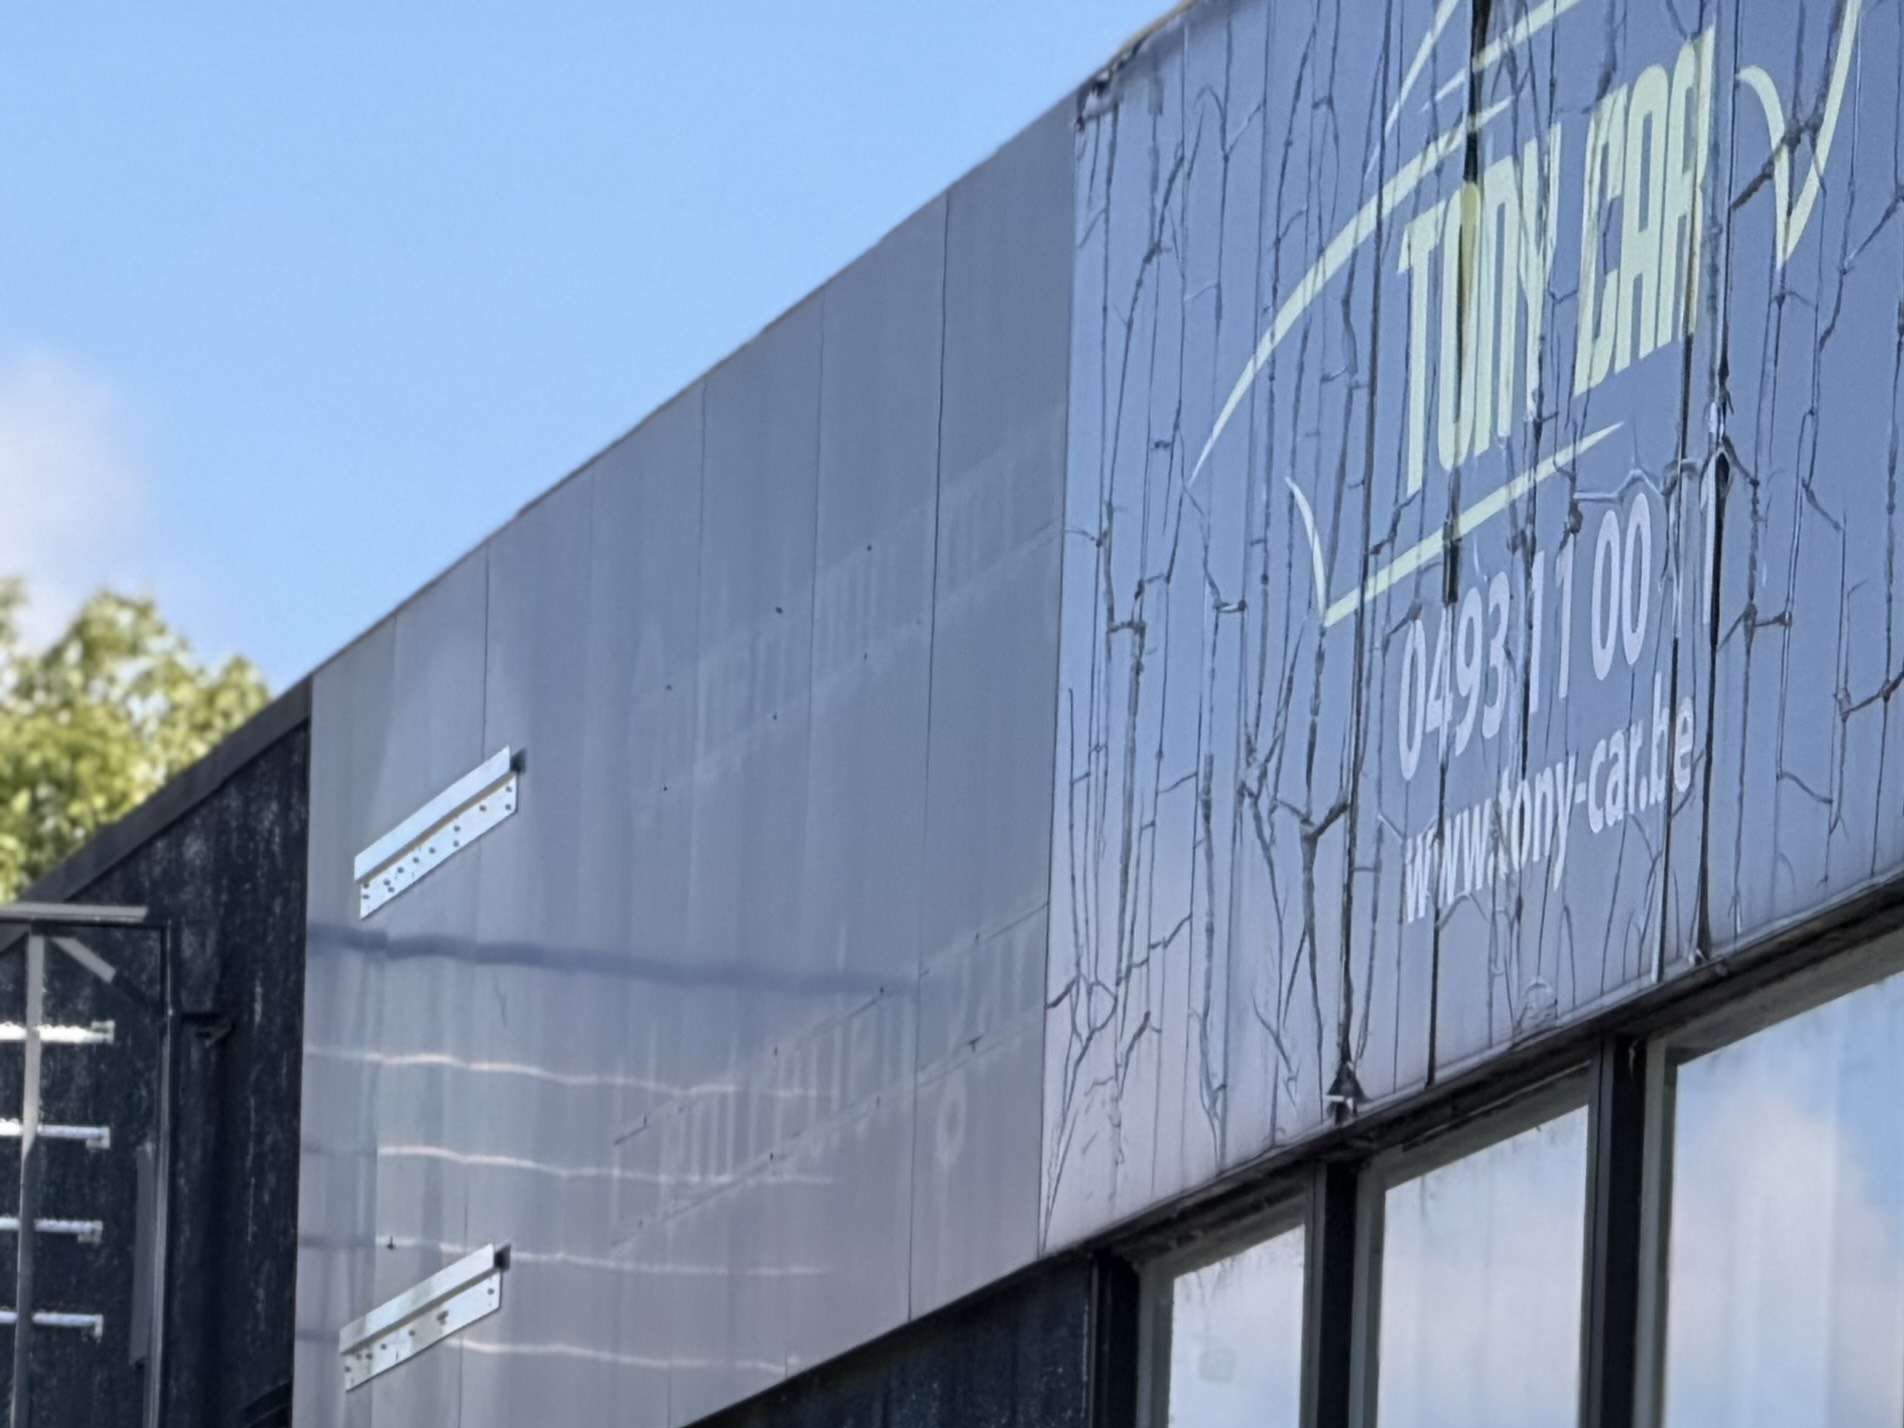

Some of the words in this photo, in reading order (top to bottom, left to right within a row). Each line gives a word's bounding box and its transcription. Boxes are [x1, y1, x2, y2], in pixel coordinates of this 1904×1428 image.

[1397, 121, 1562, 498] TONY
[1400, 571, 1510, 780] 0493
[1592, 493, 1652, 681] 00
[1406, 671, 1696, 924] www.tony-car.be
